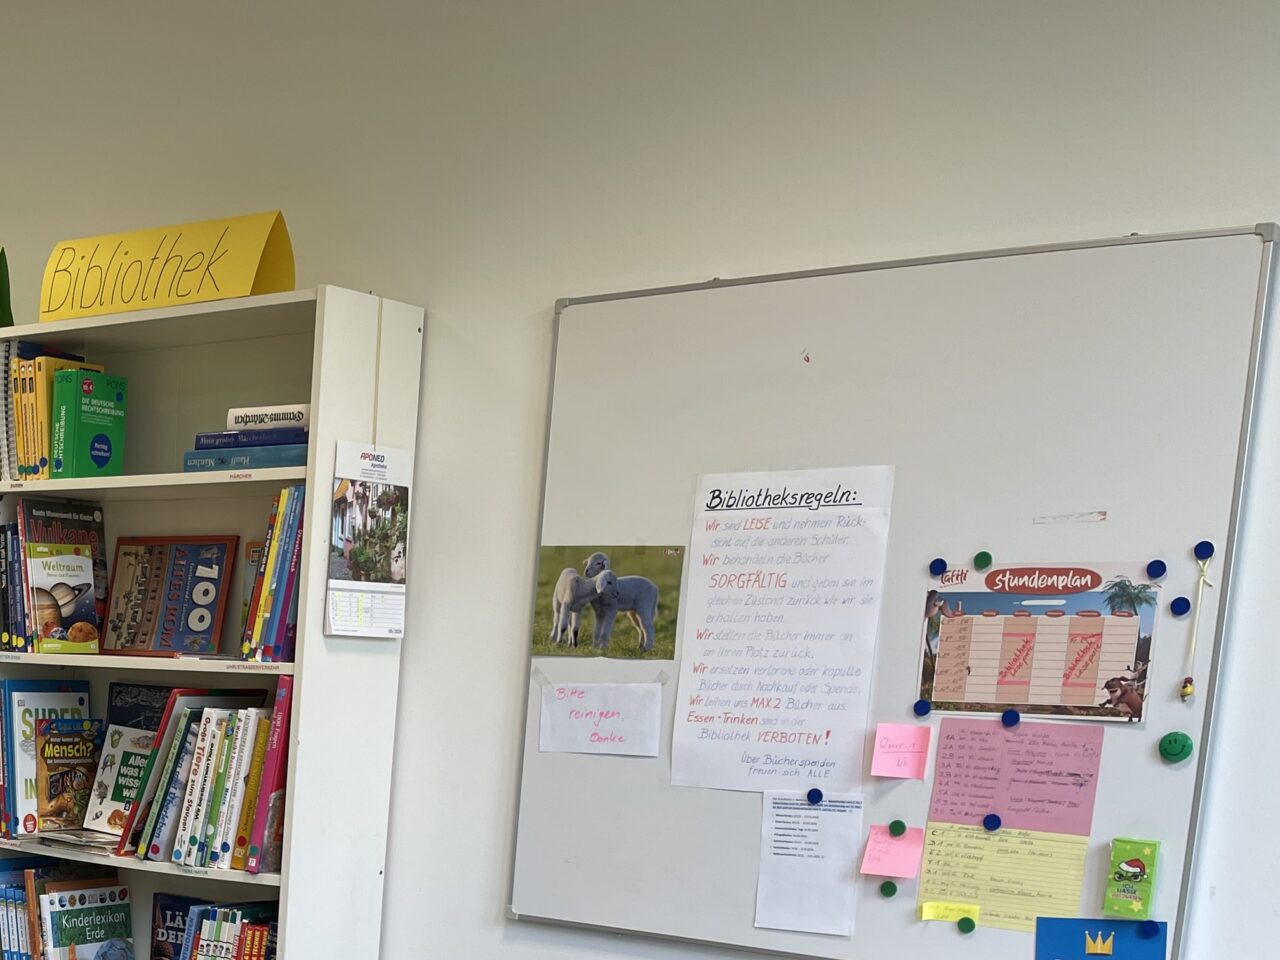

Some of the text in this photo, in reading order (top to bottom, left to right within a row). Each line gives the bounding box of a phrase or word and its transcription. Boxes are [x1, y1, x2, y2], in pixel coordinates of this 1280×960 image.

[43, 225, 232, 314] Bibliothek
[360, 452, 385, 463] APONEO
[706, 484, 857, 510] Bibliotheksregeln:
[706, 520, 720, 531] Wir
[743, 518, 771, 530] LEISE
[773, 518, 790, 529] und
[794, 519, 831, 528] nehmen
[837, 515, 867, 527] Rück-
[30, 519, 98, 545] Vulkane
[42, 561, 84, 572] Weltraum
[702, 554, 719, 566] Wir
[708, 570, 787, 588] SORGFÄLTIG
[187, 564, 219, 632] 100
[696, 629, 714, 640] Wir
[693, 663, 708, 673] Wir
[556, 688, 585, 700] Bitte
[689, 696, 702, 706] Wir
[687, 711, 715, 723] Essen
[697, 728, 751, 742] Bibliothek
[44, 742, 94, 758] Mensch?
[191, 746, 205, 777] Tiere
[119, 765, 138, 777] was
[185, 779, 196, 797] zum
[62, 911, 126, 928] Kinderlexikon
[86, 927, 105, 940] Erde
